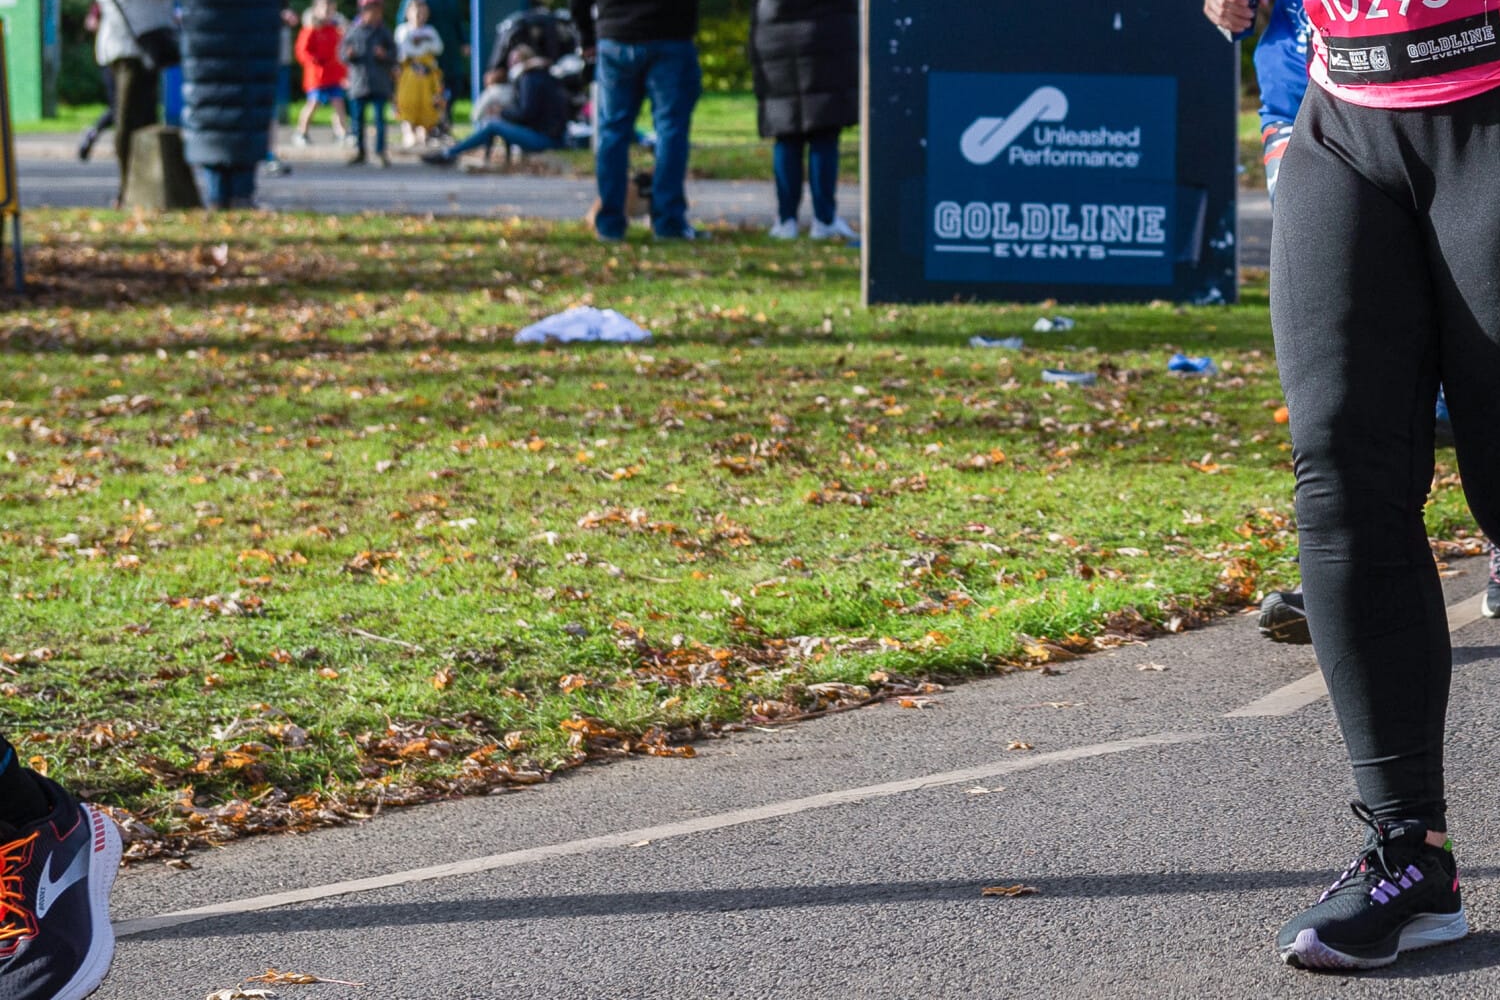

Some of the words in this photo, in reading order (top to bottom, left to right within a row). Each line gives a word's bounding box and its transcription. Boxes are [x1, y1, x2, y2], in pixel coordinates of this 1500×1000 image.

[1407, 25, 1495, 58] GOLDLINE
[1432, 45, 1475, 61] EVENTS
[1033, 126, 1141, 148] Unleashed
[1009, 147, 1140, 168] Performance
[934, 201, 1166, 243] GOLDLINE
[993, 243, 1106, 259] EVENTS
